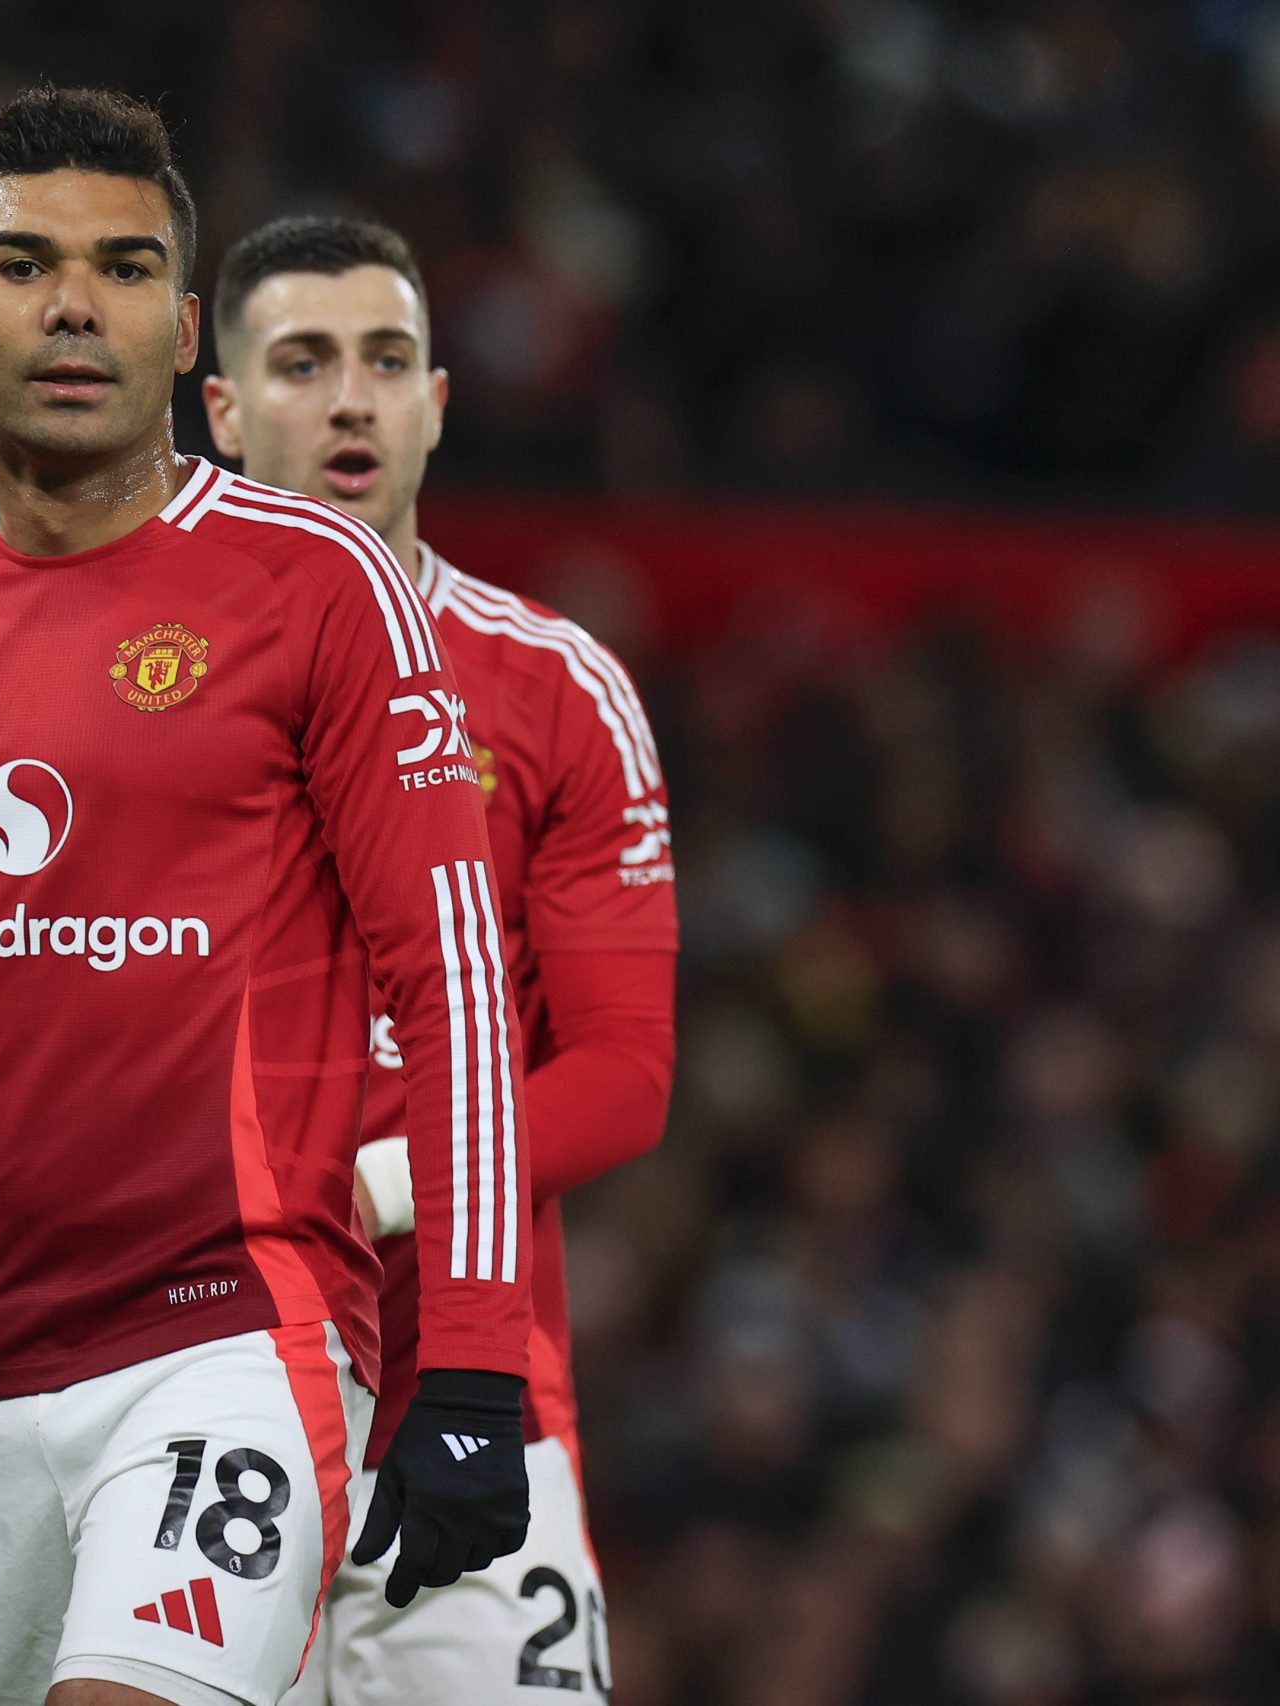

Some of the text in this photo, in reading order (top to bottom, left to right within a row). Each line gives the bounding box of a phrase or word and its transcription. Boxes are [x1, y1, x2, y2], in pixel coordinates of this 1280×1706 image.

[124, 630, 201, 658] MANCHESTER
[127, 689, 182, 705] UNITED
[168, 1279, 238, 1305] HEAT.RDY
[153, 1439, 291, 1580] 18
